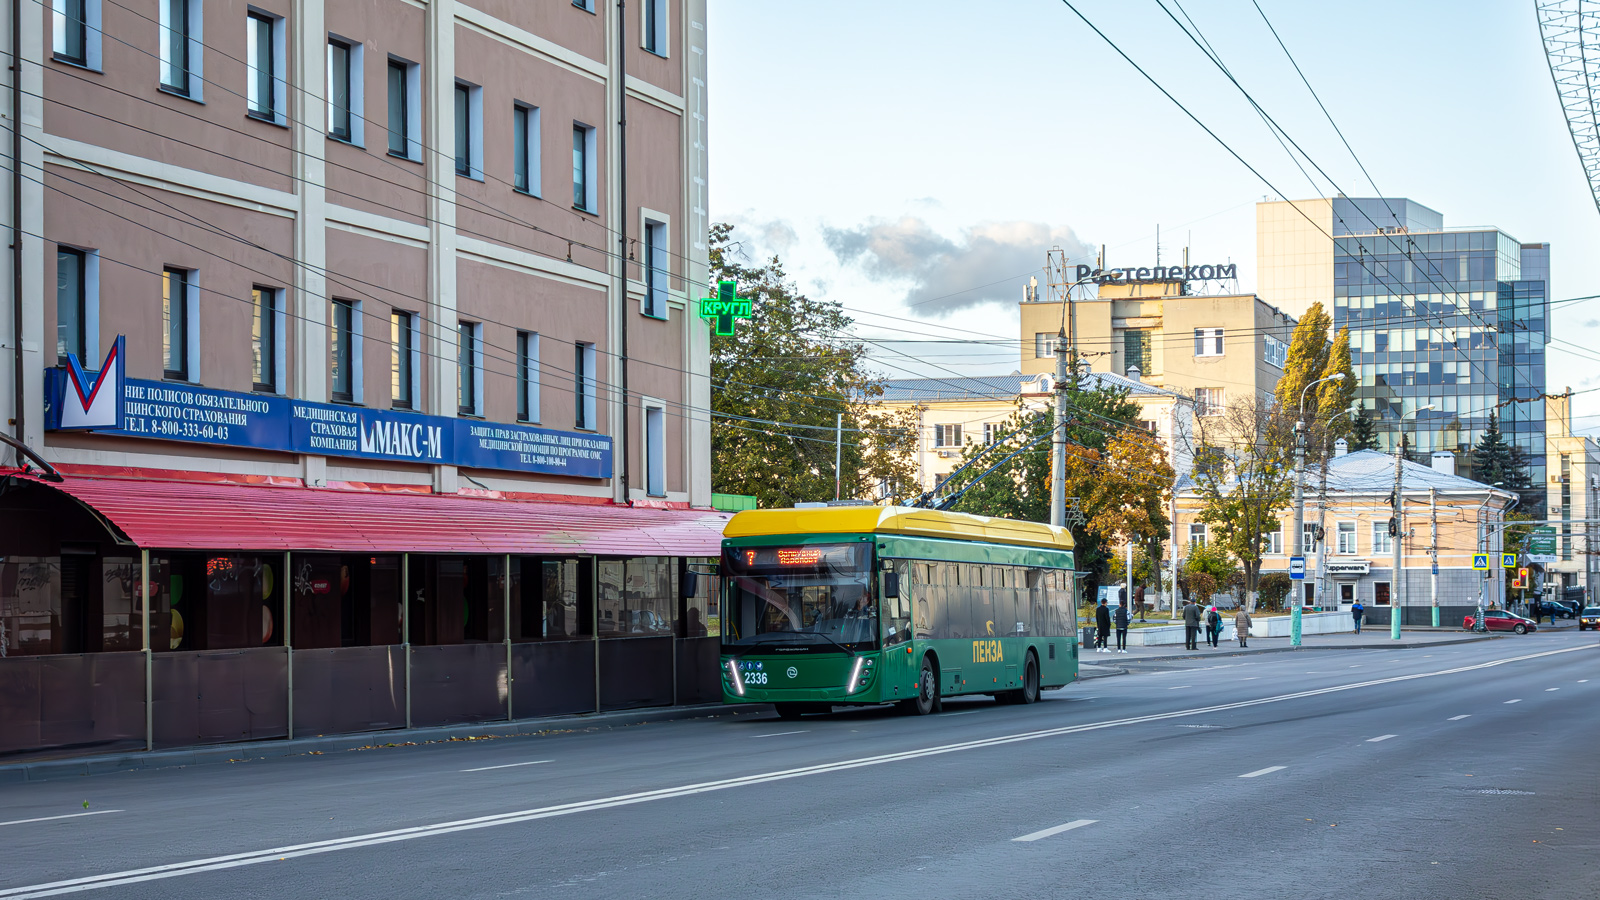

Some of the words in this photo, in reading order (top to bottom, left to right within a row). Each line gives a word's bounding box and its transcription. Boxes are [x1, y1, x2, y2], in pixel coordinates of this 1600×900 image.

[1076, 263, 1237, 284] Ростелеком
[703, 301, 749, 315] КРУГЛ
[125, 385, 145, 400] НИЕ
[147, 387, 194, 405] ПОЛИСОВ
[195, 392, 269, 414] ОБЯЗАТЕЛЬНОГО
[182, 406, 247, 426] СТРАХОВАНИЯ
[293, 405, 357, 424] МЕДИЦИНСКАЯ
[124, 417, 149, 433] ТЕЛ.
[151, 420, 229, 440] 8-800-333-60-03
[310, 421, 357, 438] СТРАХОВАЯ
[470, 425, 494, 438] ЗАЩИТА
[495, 428, 510, 440] ПРАВ
[510, 430, 559, 445] ЗАСТРАХОВАННЫХ
[559, 435, 572, 447] ЛИЦ
[572, 437, 582, 448] ПРИ
[582, 438, 610, 451] ОКАЗАНИИ
[310, 435, 357, 451] КОМПАНИЯ
[375, 420, 442, 459] МАКС-М
[479, 438, 523, 452] МЕДИЦИНСКОЙ
[523, 443, 550, 455] ПОМОЩИ
[550, 446, 558, 455] ПО
[558, 447, 589, 459] ПРОГРАММЕ
[747, 550, 755, 566] 7
[972, 640, 1004, 663] ПЕНЗА
[744, 672, 768, 685] 2336
